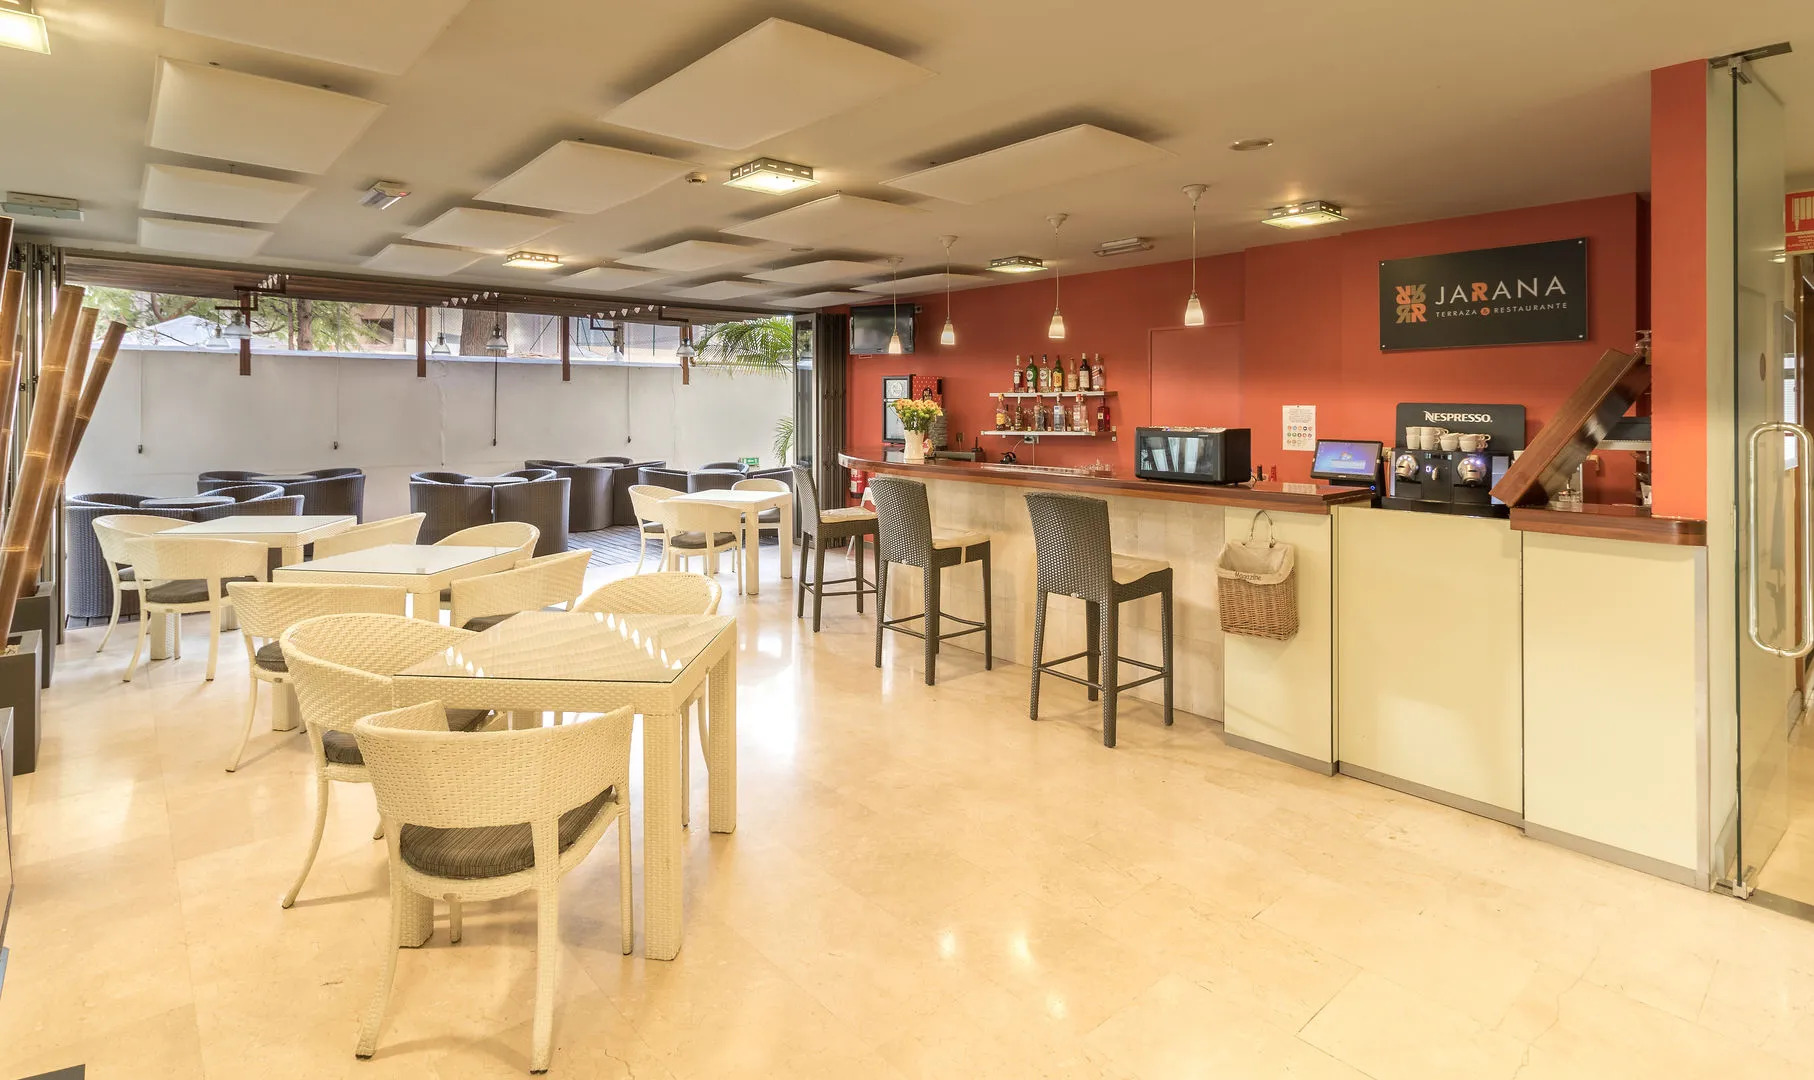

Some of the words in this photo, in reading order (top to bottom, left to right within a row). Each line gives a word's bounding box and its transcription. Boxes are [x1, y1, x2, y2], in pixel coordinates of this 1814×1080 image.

[1435, 275, 1567, 305] JARANA
[1435, 309, 1478, 318] TERRAZA
[1493, 302, 1568, 314] RESTAURANTE
